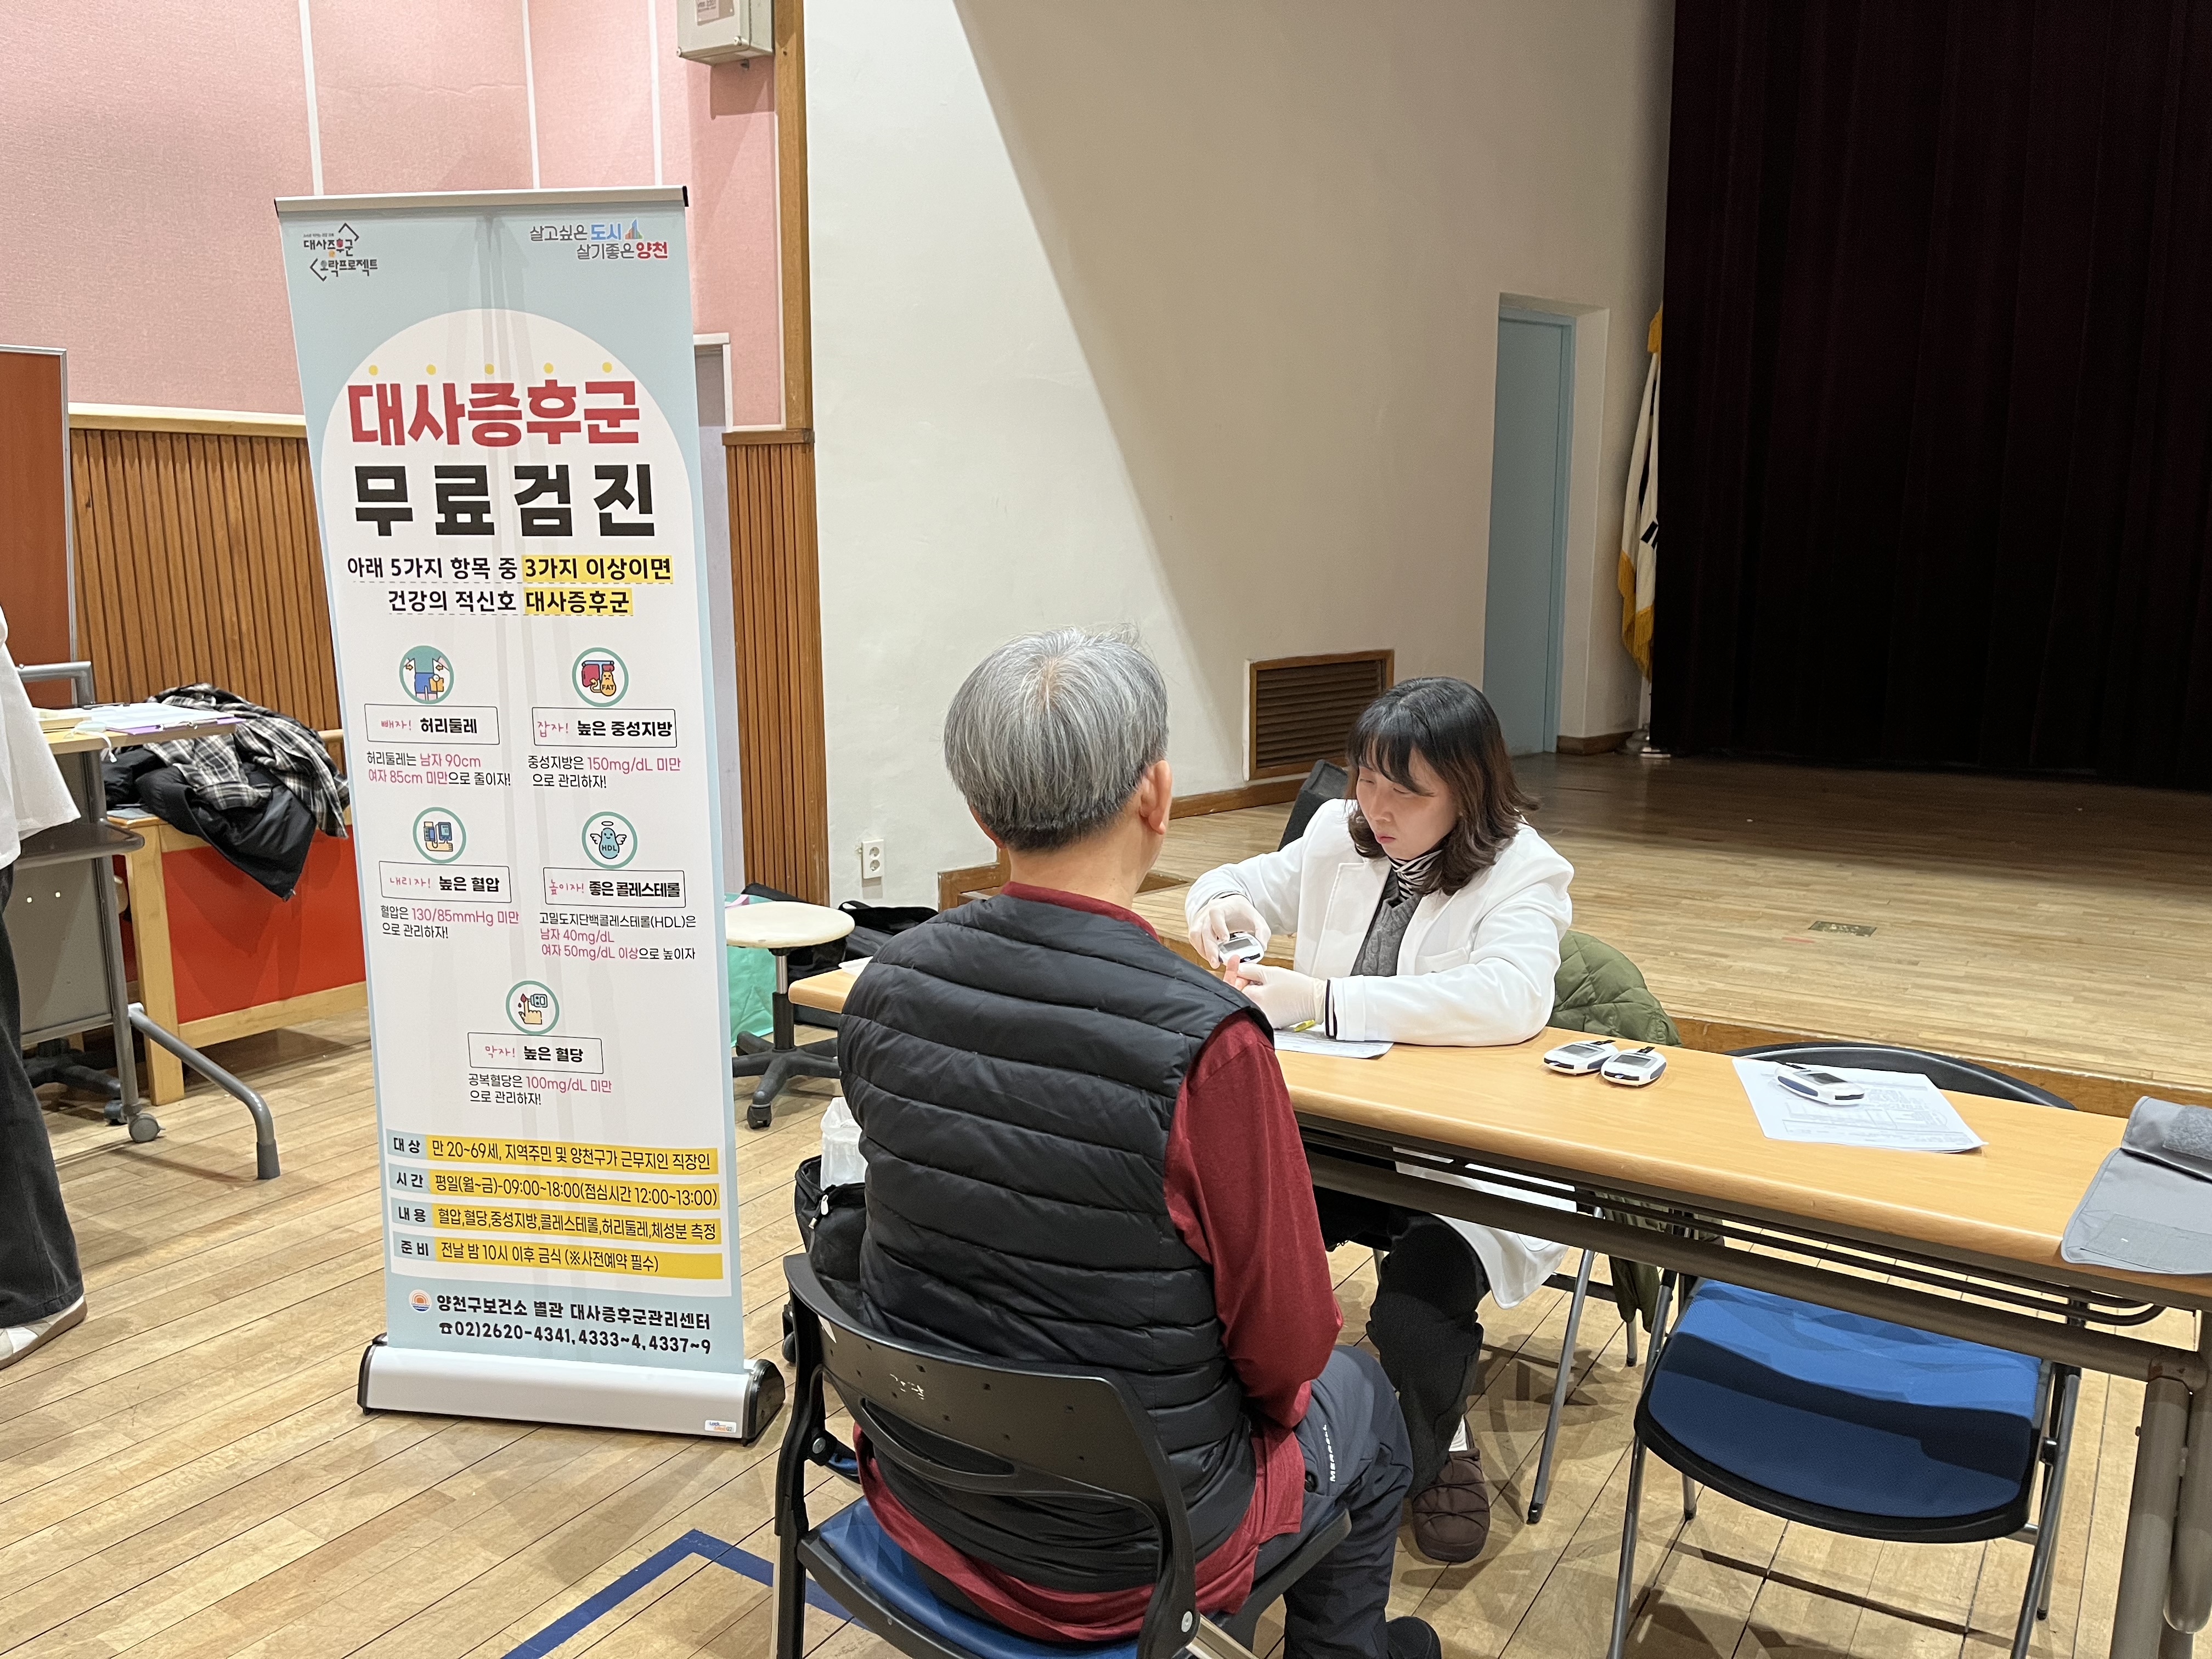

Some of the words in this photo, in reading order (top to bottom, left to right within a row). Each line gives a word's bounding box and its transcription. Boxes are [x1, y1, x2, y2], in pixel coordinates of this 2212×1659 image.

[530, 225, 588, 241] 살고싶은
[591, 224, 621, 240] 도시
[577, 243, 634, 259] 살기좋은
[636, 242, 667, 258] 양천
[348, 379, 640, 447] 대사증후군
[354, 464, 656, 538] 무료검진
[348, 557, 383, 578] 아래
[392, 558, 442, 578] 5가지
[450, 557, 490, 579] 항목
[499, 558, 517, 579] 중
[525, 558, 577, 579] 3가지
[587, 558, 671, 580] 이상이면
[389, 591, 447, 612] 건강의
[456, 591, 516, 612] 적신호
[526, 591, 629, 613] 대사증후군
[420, 718, 477, 733] 허리둘레
[538, 721, 568, 737] 잡자!
[578, 721, 606, 736] 높은
[612, 721, 672, 736] 중성지방
[367, 751, 416, 766] 허리둘레는
[420, 753, 442, 766] 남자
[445, 754, 481, 767] 90cm
[528, 755, 584, 770] 중성지방은
[588, 757, 653, 774] 150mg/dL
[657, 758, 681, 771] 미만
[369, 769, 387, 782] 여자
[390, 770, 422, 783] 85cm
[427, 771, 470, 784] 미만으로
[474, 772, 510, 786] 줄이자!
[533, 774, 554, 786] 으로
[558, 774, 606, 788] 관리하자!
[390, 877, 430, 888] 내리자!
[439, 876, 466, 891] 높은
[471, 877, 499, 891] 혈압
[549, 879, 584, 895] 높이자!
[589, 881, 614, 896] 좋은
[617, 882, 680, 897] 콜레스테롤
[381, 905, 408, 919] 혈압은
[412, 908, 493, 927] 130/85mmHg
[498, 911, 519, 924] 미만
[540, 913, 696, 928] 고밀도지단백콜레스테롤(HDL)은
[383, 923, 400, 935] 으로
[404, 924, 448, 939] 관리하자!
[540, 928, 560, 940] 남자
[563, 929, 614, 945] 40mg/dL
[542, 944, 561, 956] 여자
[565, 945, 615, 961] 50mg/dL
[619, 947, 659, 959] 이상으로
[663, 948, 695, 960] 높이자
[524, 1046, 551, 1060] 높은
[556, 1048, 583, 1062] 혈당
[469, 1074, 522, 1087] 공복혈당은
[526, 1076, 587, 1093] 100mg/dL
[591, 1080, 612, 1093] 미만
[471, 1091, 491, 1102] 으로
[495, 1091, 541, 1105] 관리하자!
[432, 1140, 444, 1156] 만
[505, 1144, 551, 1162] 지역주민
[556, 1147, 567, 1163] 및
[571, 1148, 617, 1166] 양천구가
[621, 1151, 668, 1169] 근무지인
[673, 1153, 710, 1170] 직장인
[691, 1223, 715, 1240] 측정
[441, 1242, 464, 1259] 전날
[468, 1244, 479, 1259] 밤
[483, 1245, 507, 1261] 10시
[512, 1246, 535, 1262] 이후
[539, 1248, 561, 1264] 금식
[631, 1255, 658, 1272] 필수)
[437, 1295, 527, 1316] 양천구보건소
[534, 1301, 563, 1318] 별관
[571, 1304, 709, 1329] 대사증후군관리센터
